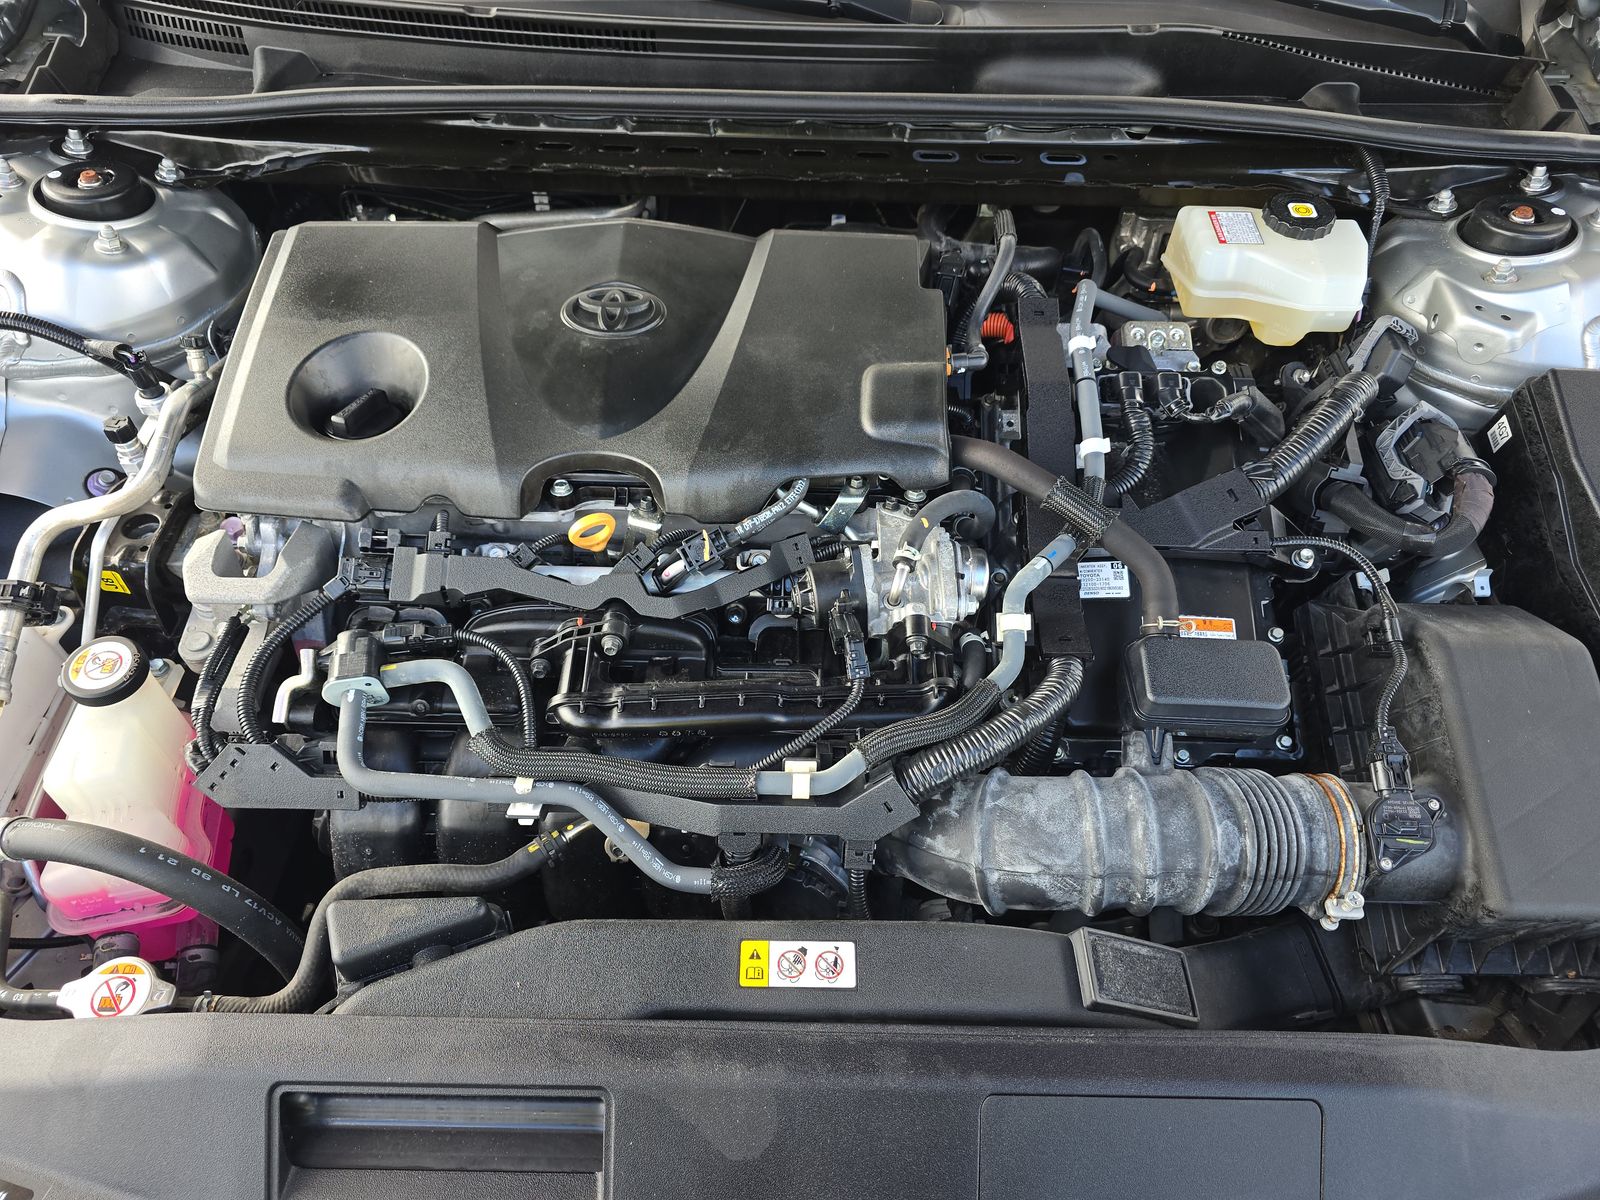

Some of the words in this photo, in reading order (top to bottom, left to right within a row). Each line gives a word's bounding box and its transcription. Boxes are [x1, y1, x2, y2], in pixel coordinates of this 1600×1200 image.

[1496, 421, 1510, 441] 4G7
[157, 853, 179, 866] 21
[221, 883, 241, 898] LP
[244, 898, 282, 926] ACV17
